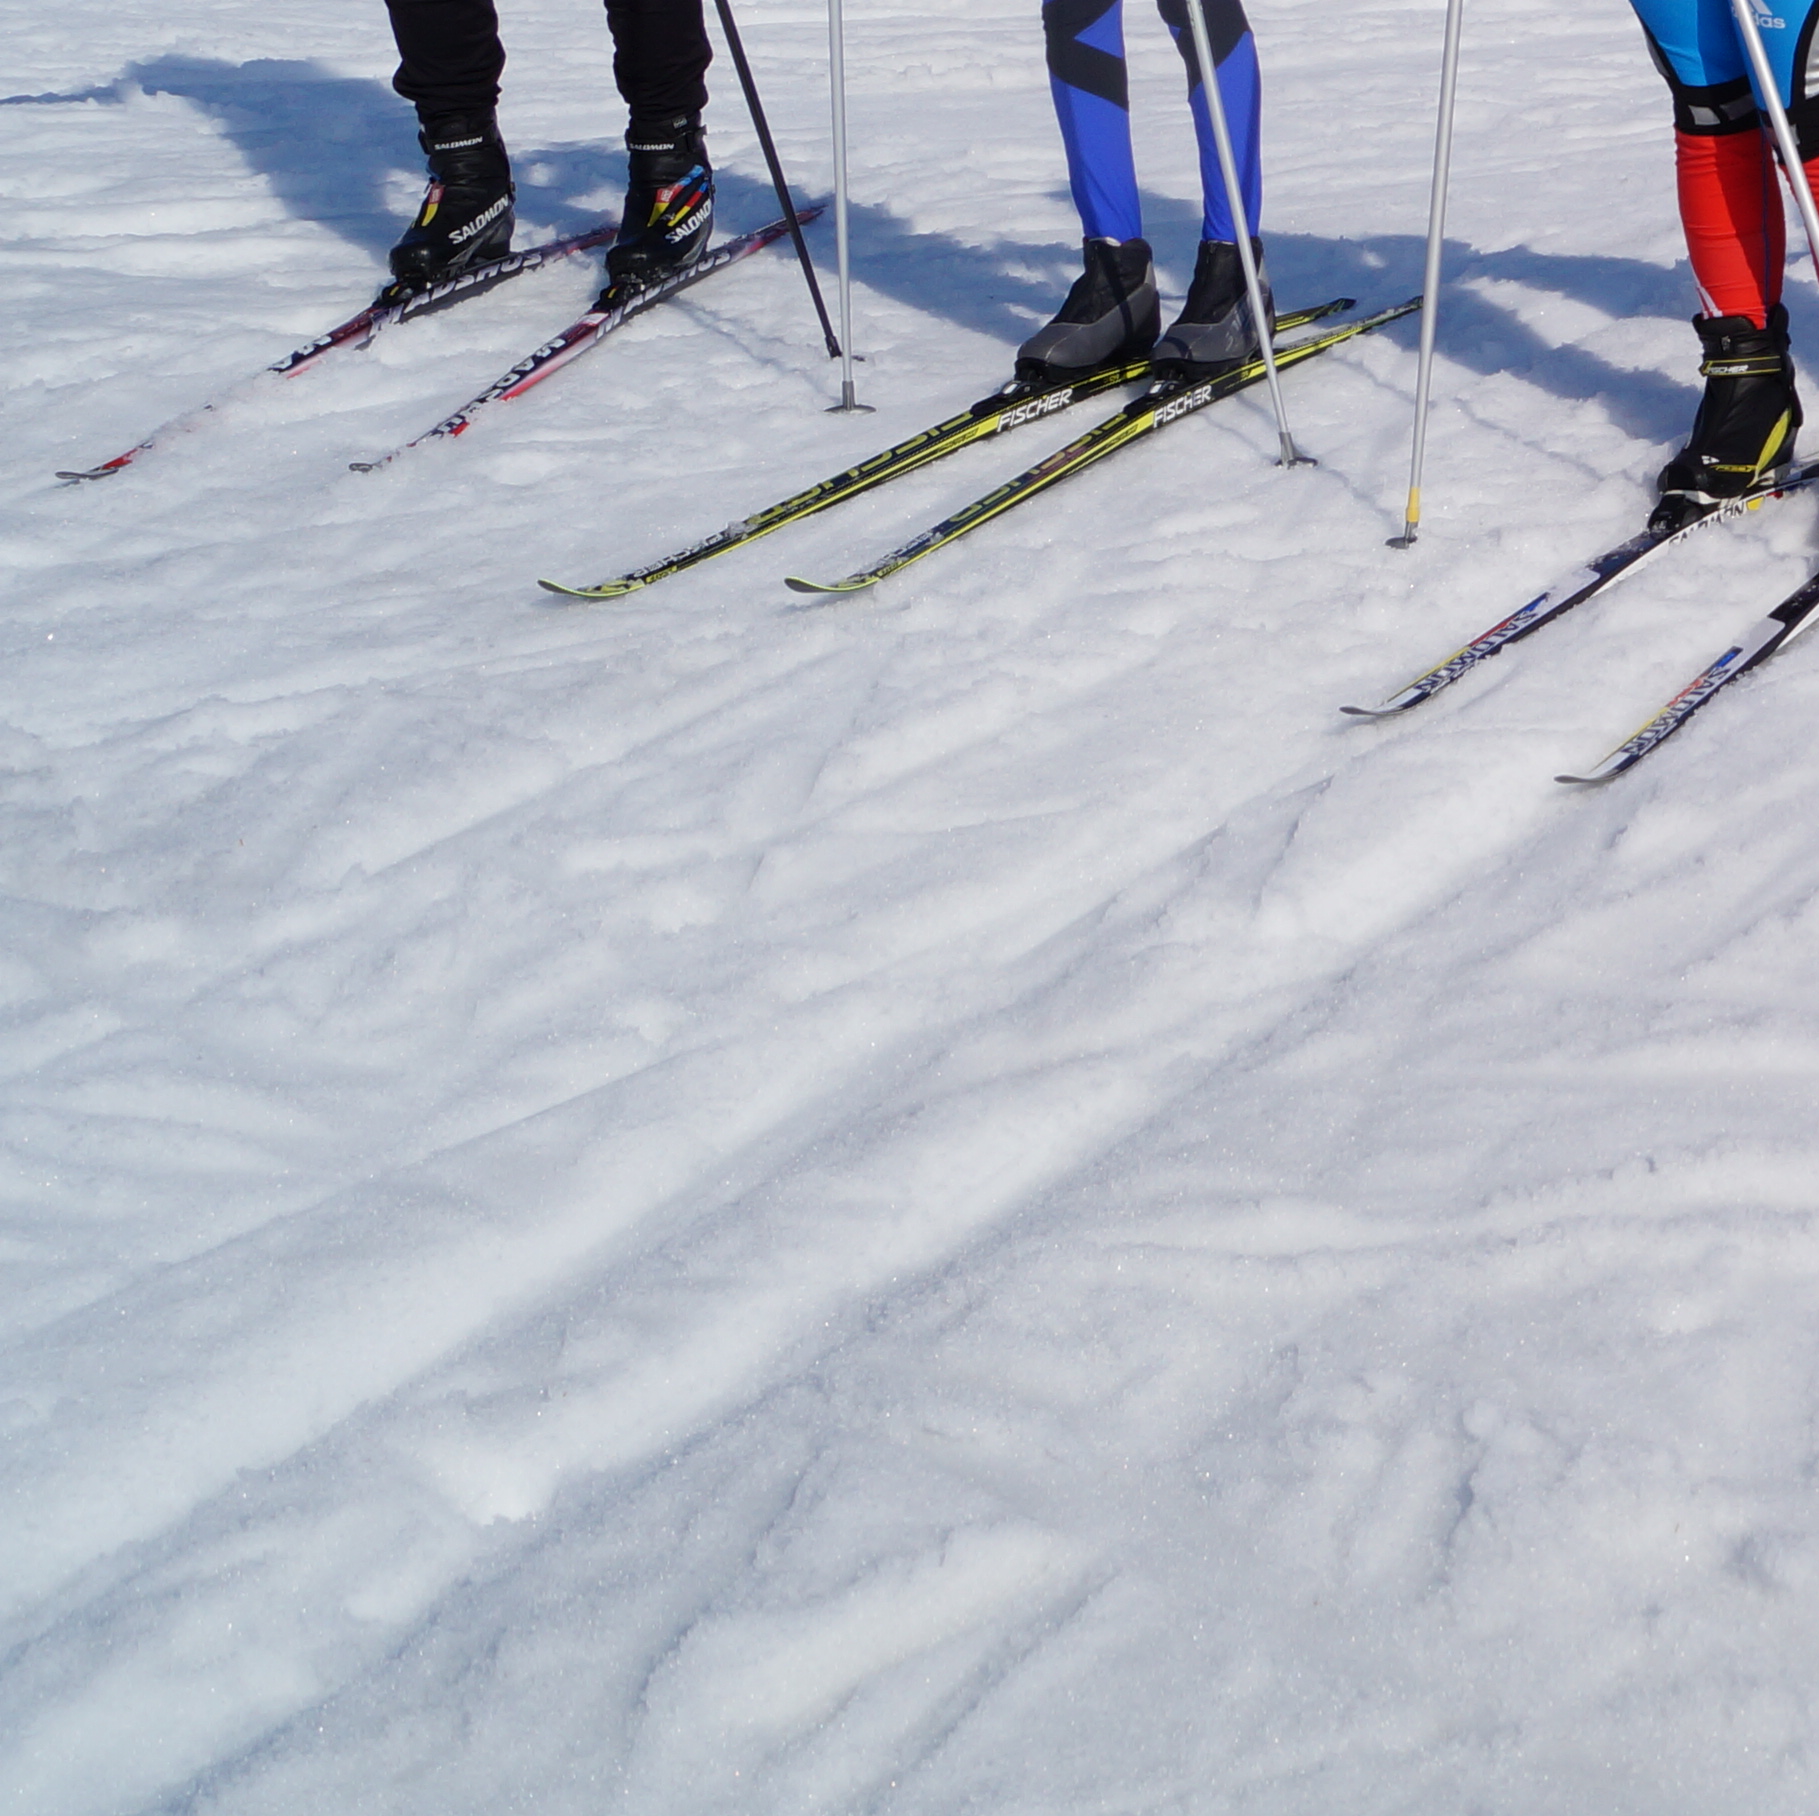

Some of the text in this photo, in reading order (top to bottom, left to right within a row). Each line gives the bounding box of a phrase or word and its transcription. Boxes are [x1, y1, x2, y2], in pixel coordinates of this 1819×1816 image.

[434, 136, 483, 151] SALOMON
[448, 194, 509, 245] SALOMON
[997, 387, 1073, 432] FISCHER
[1154, 384, 1212, 429] FISCHER
